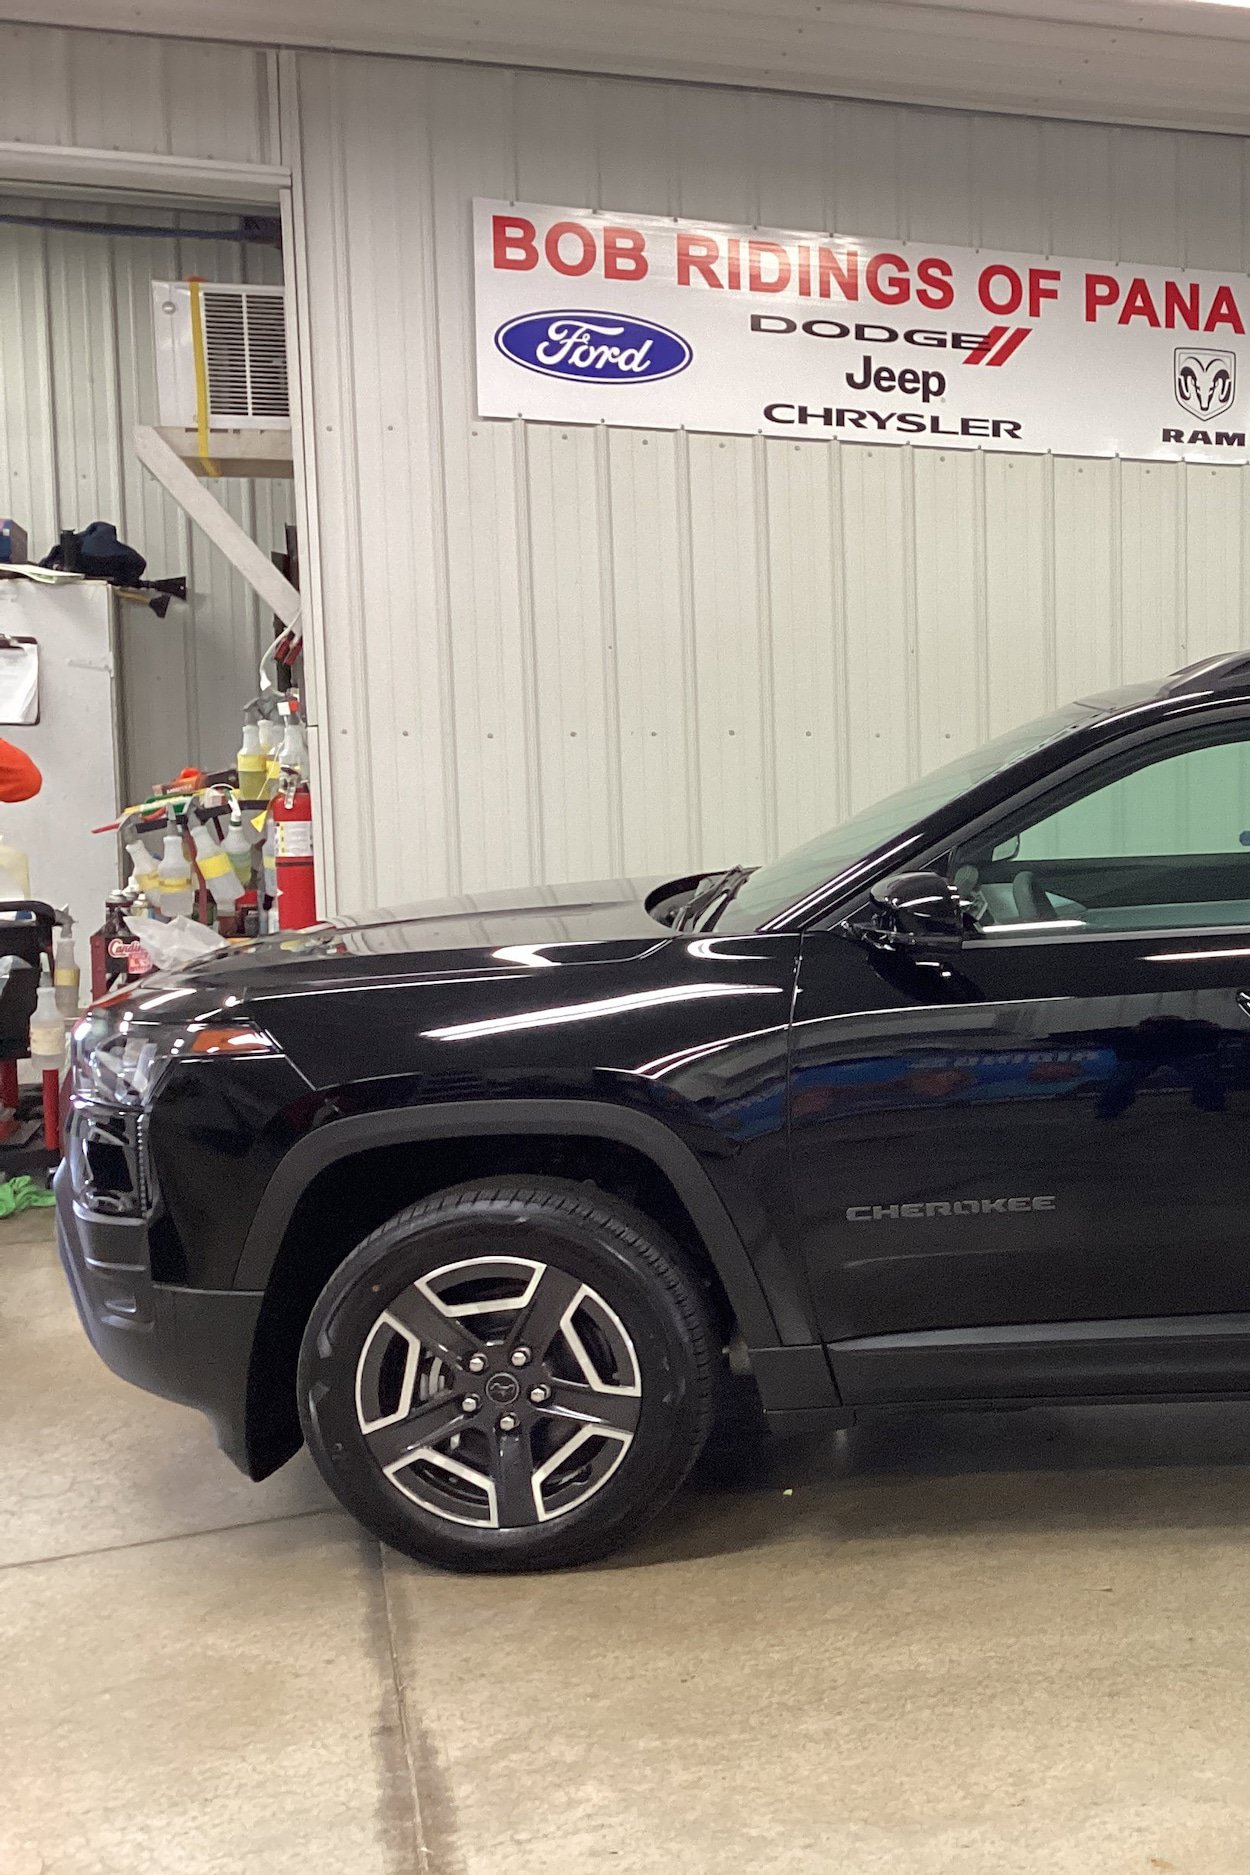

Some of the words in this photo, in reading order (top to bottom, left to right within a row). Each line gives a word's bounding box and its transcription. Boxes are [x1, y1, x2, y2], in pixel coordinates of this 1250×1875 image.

[492, 215, 648, 281] BOB
[677, 233, 954, 310] RIDINGS
[978, 264, 1061, 317] OF
[1085, 273, 1246, 335] PANA
[536, 320, 653, 373] Ford
[750, 314, 992, 351] DODGE
[845, 355, 946, 403] Jeep
[763, 403, 1023, 439] CHRYSLER
[1162, 428, 1246, 447] RAM
[846, 1196, 1056, 1221] CHEROKEE
